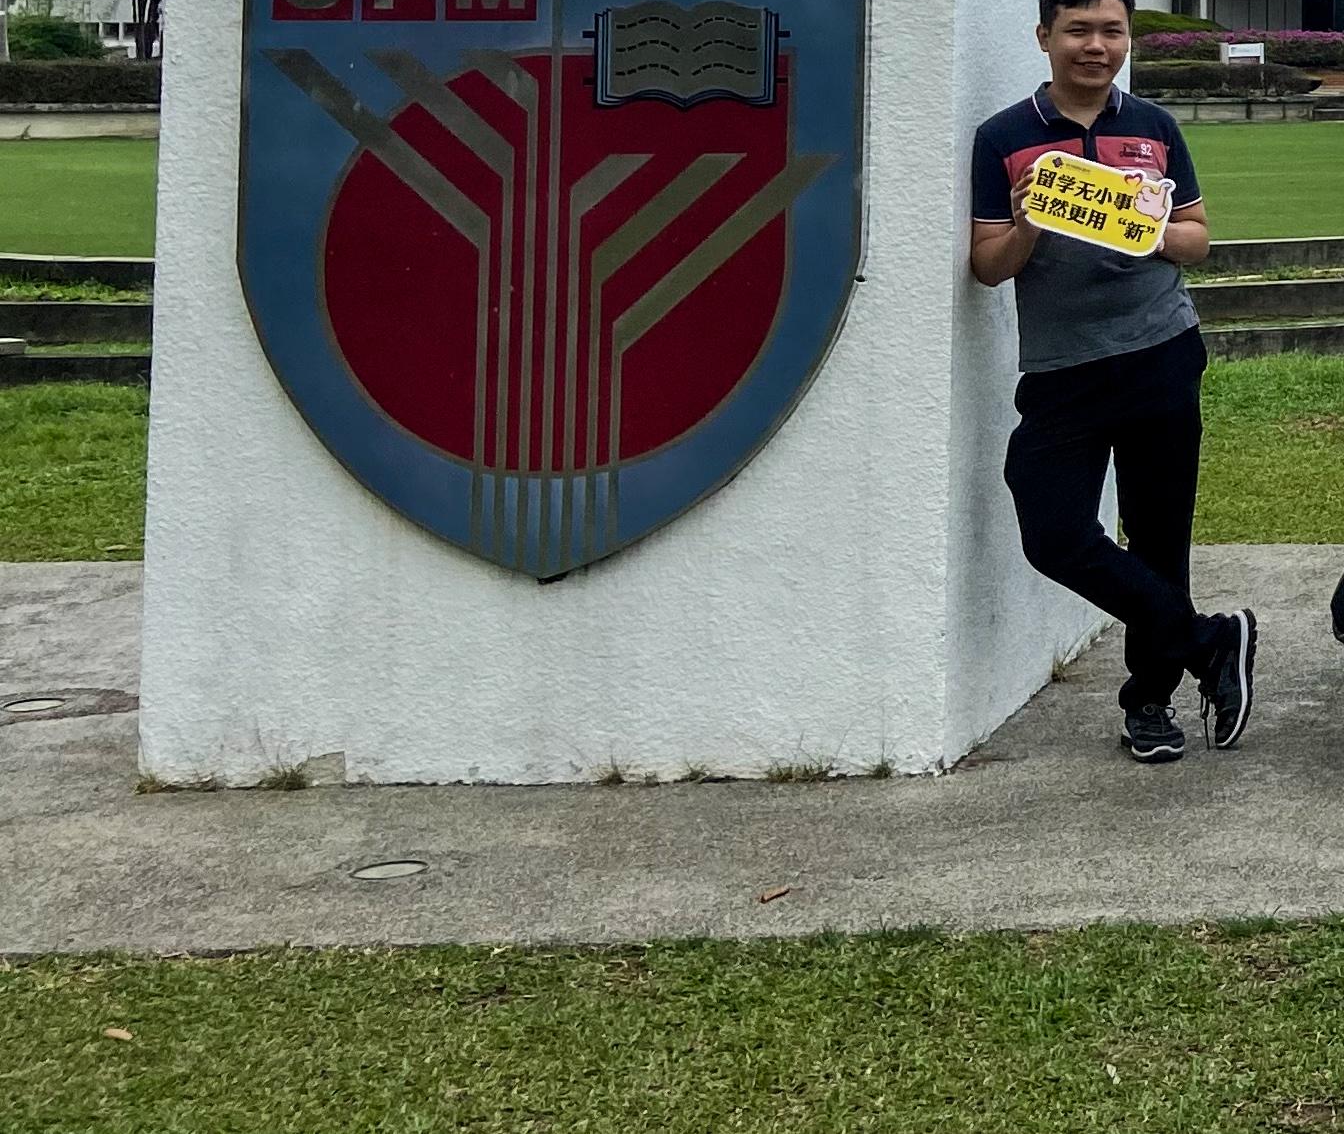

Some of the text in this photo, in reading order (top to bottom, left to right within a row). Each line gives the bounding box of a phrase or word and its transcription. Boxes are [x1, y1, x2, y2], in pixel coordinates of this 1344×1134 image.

[1036, 168, 1134, 211] 留学无小事
